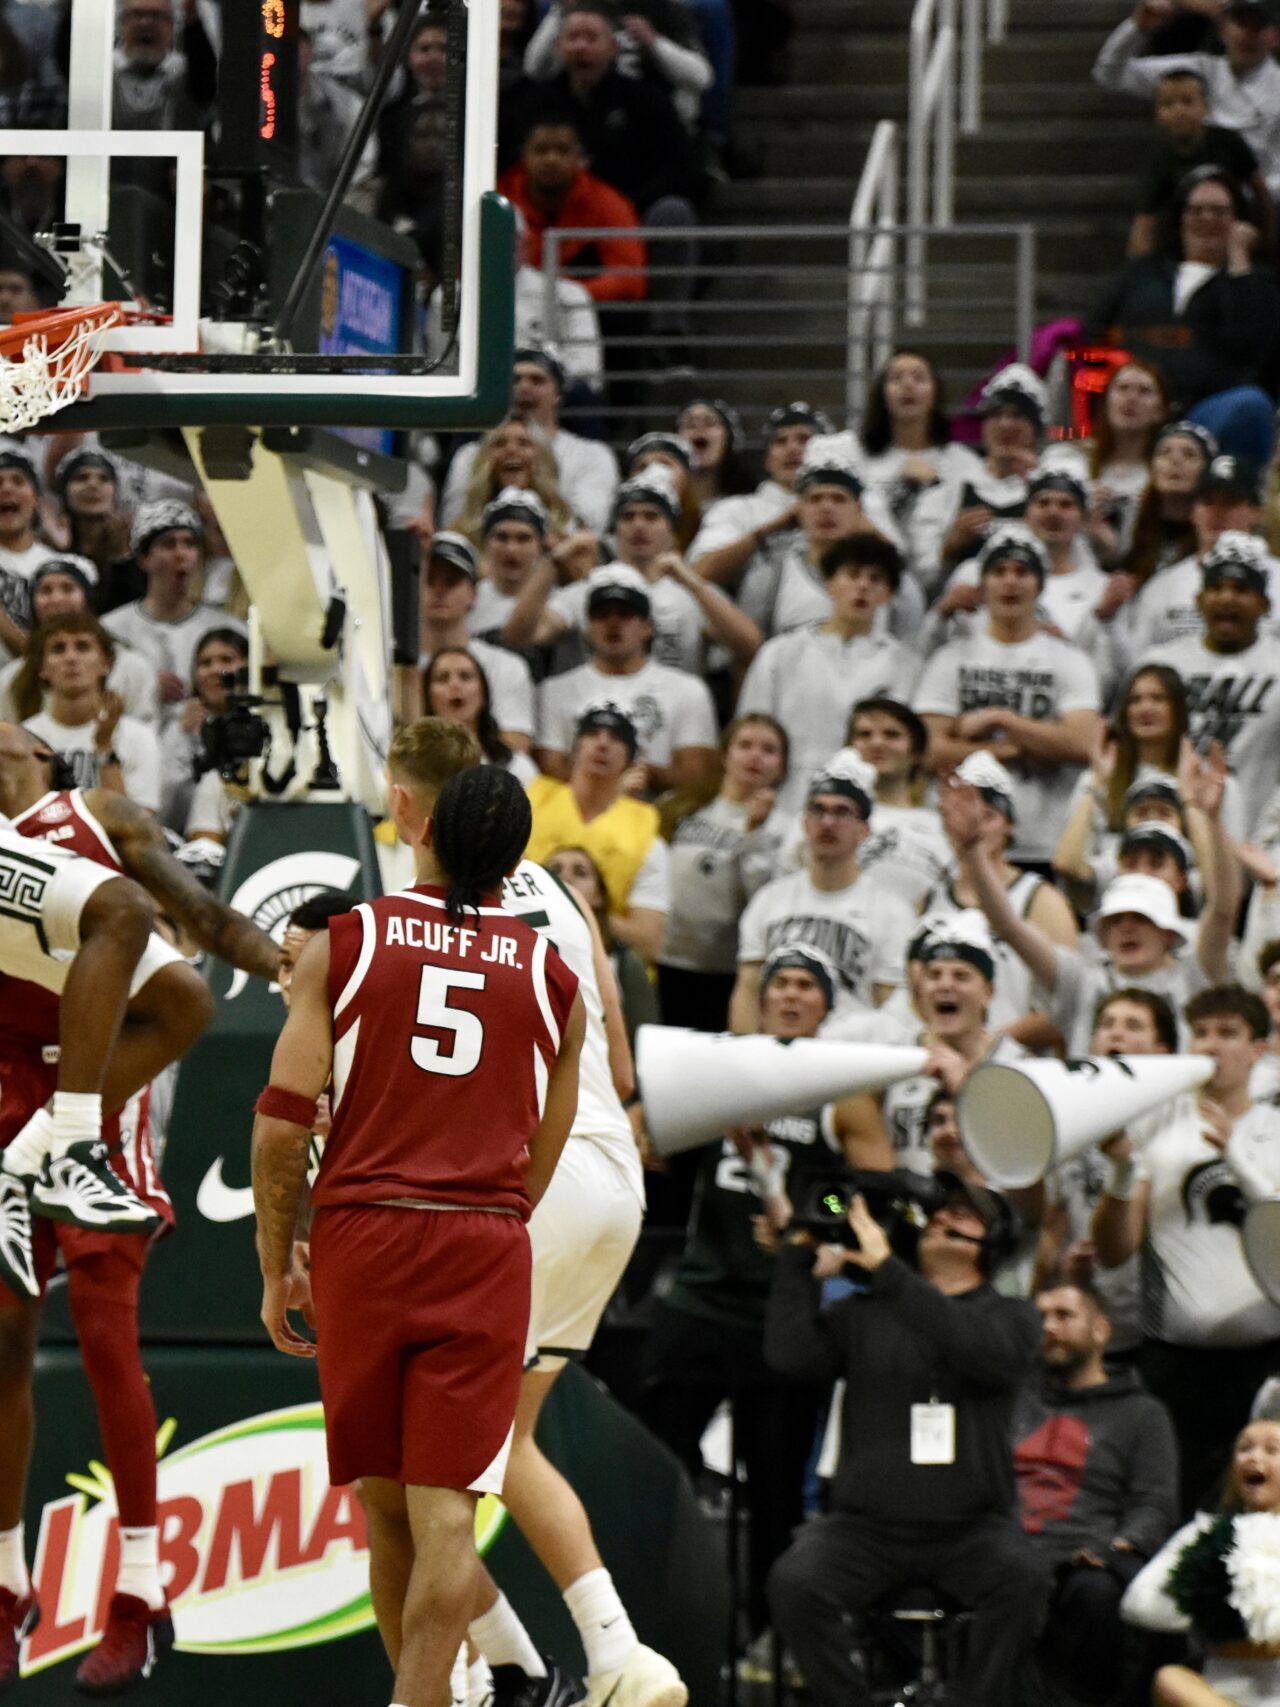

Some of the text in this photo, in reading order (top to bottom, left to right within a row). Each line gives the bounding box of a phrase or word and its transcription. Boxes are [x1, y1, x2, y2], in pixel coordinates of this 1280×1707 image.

[385, 916, 524, 970] ACUFF JR.
[410, 963, 486, 1077] 5
